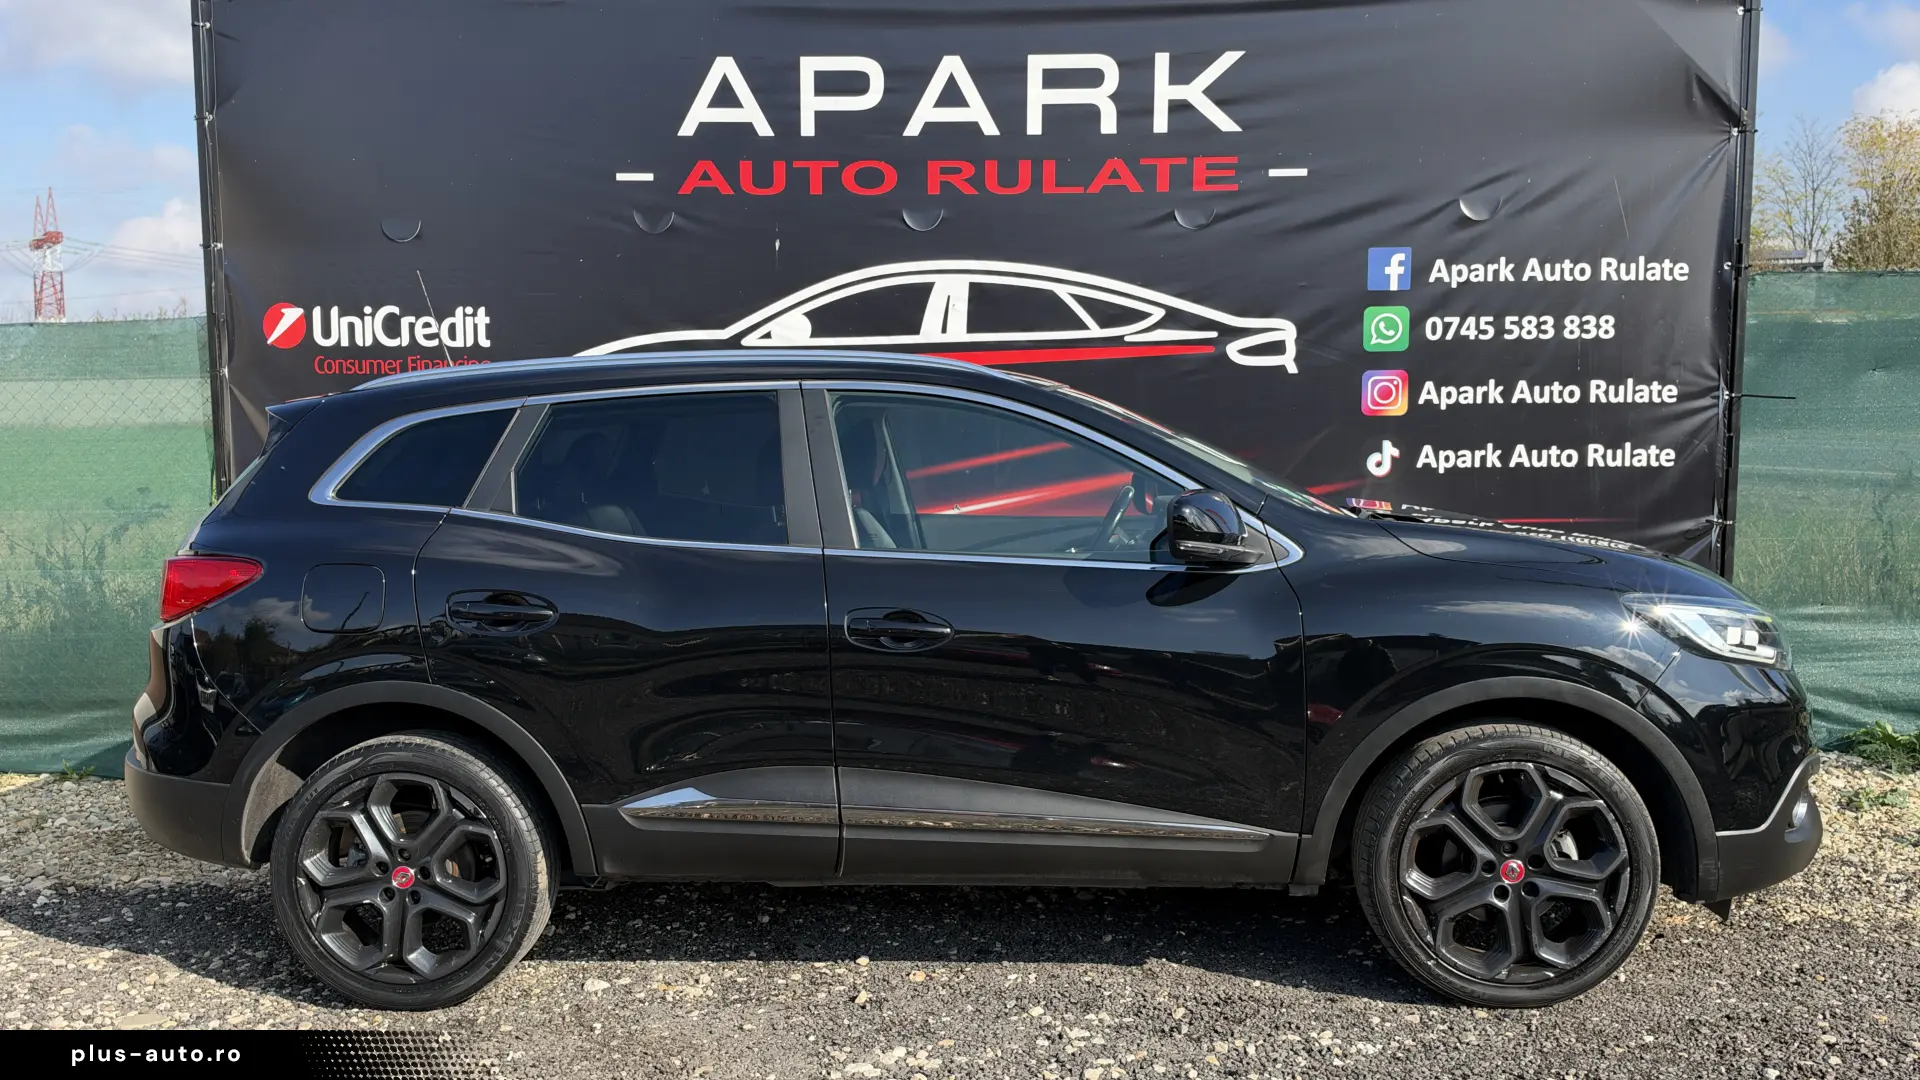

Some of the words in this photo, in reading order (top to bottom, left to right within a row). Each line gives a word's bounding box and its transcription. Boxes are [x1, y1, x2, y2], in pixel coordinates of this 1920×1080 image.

[677, 51, 1246, 137] APARK
[677, 159, 898, 196] AUTO
[926, 155, 1239, 196] RULATE
[1428, 255, 1516, 289] Apark
[1522, 256, 1593, 283] Auto
[1600, 254, 1690, 282] Rulate
[312, 304, 491, 348] UniCredit
[1424, 315, 1496, 342] 0745
[1503, 314, 1556, 341] 583
[1562, 314, 1616, 340] 838
[313, 354, 403, 375] Consumer
[1417, 378, 1504, 411] Apark
[1510, 379, 1581, 405] Auto
[1589, 377, 1679, 404] Rulate
[1415, 442, 1503, 475] Apark
[1508, 443, 1579, 469] Auto
[1586, 441, 1676, 468] Rulate
[1542, 741, 1628, 804] NEXEN
